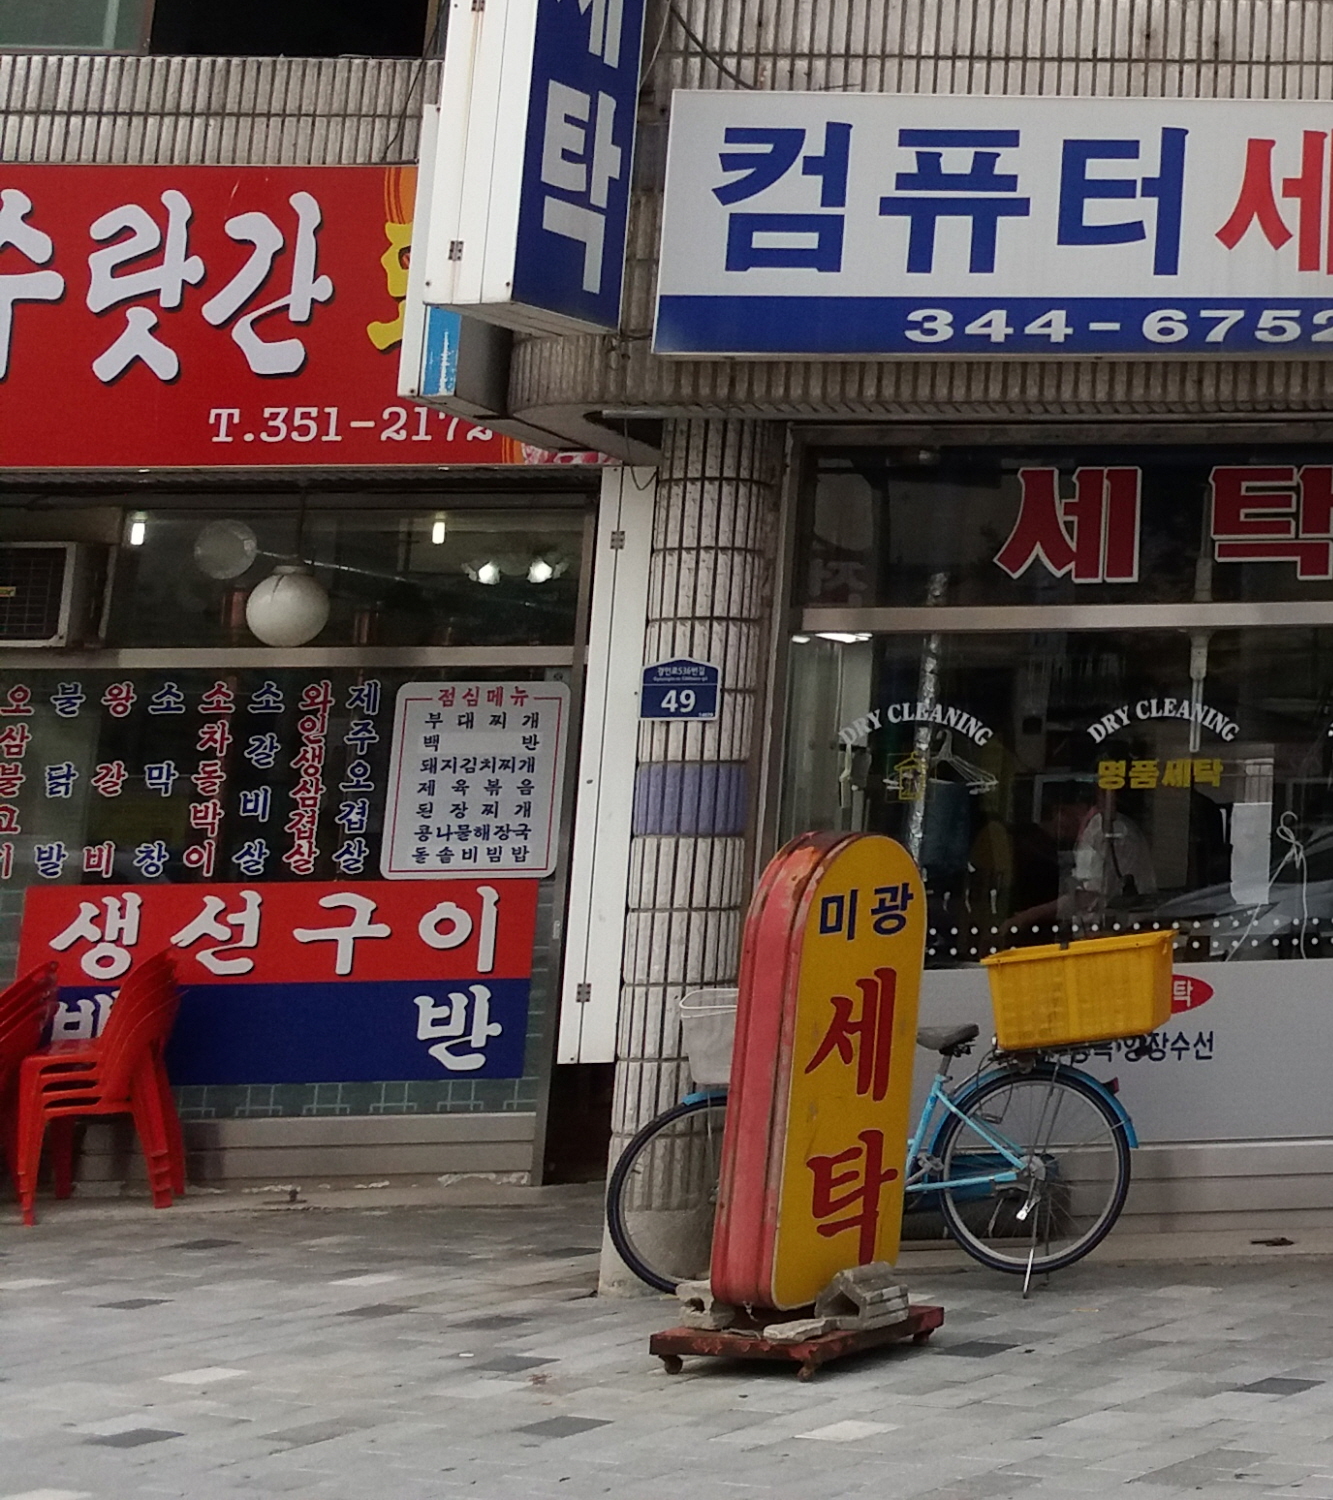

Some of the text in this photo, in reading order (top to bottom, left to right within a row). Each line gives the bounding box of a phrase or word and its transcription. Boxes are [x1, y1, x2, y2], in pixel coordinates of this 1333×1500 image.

[437, 685, 529, 708] 점심메뉴
[660, 689, 696, 713] 49
[1086, 698, 1240, 745] DRY CLEANING
[837, 701, 994, 748] DRY CLEANING
[0, 683, 35, 879] 오삼불고
[49, 885, 500, 979] 생선구이
[819, 882, 914, 941] 미광
[804, 967, 898, 1267] 세탁
